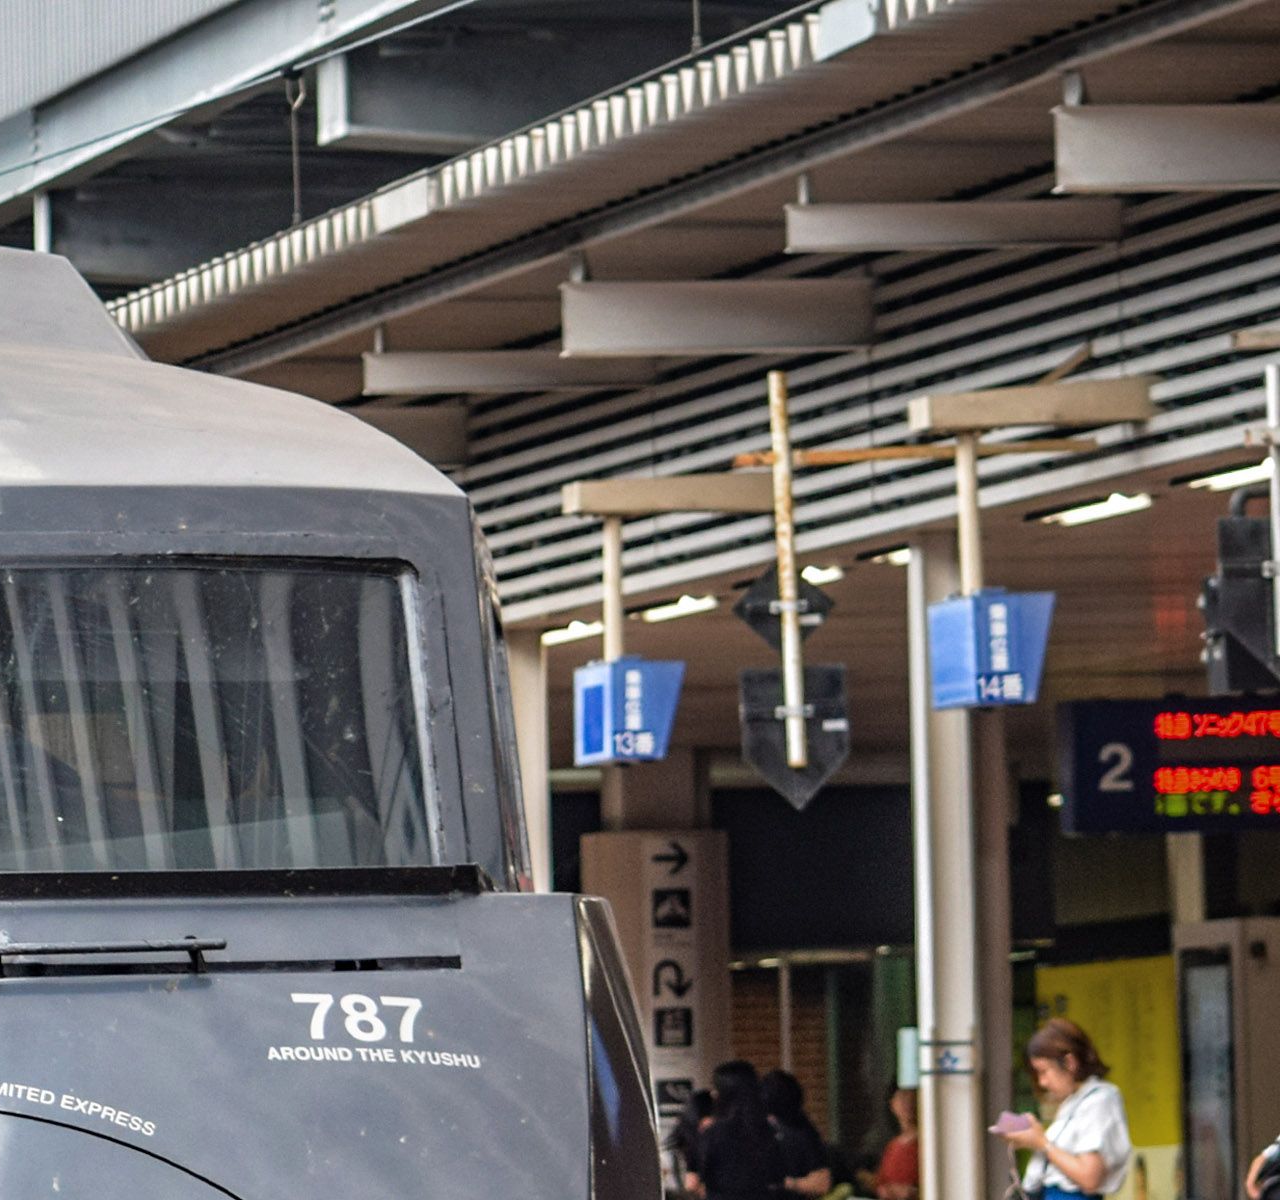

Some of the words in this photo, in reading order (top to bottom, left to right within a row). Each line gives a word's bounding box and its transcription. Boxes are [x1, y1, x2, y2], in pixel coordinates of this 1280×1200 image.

[1098, 742, 1135, 792] 2
[290, 993, 423, 1043] 787
[267, 1046, 353, 1062] AROUND
[355, 1047, 397, 1063] THE
[400, 1050, 482, 1069] KYUSHU
[59, 1093, 157, 1138] EXPRESS
